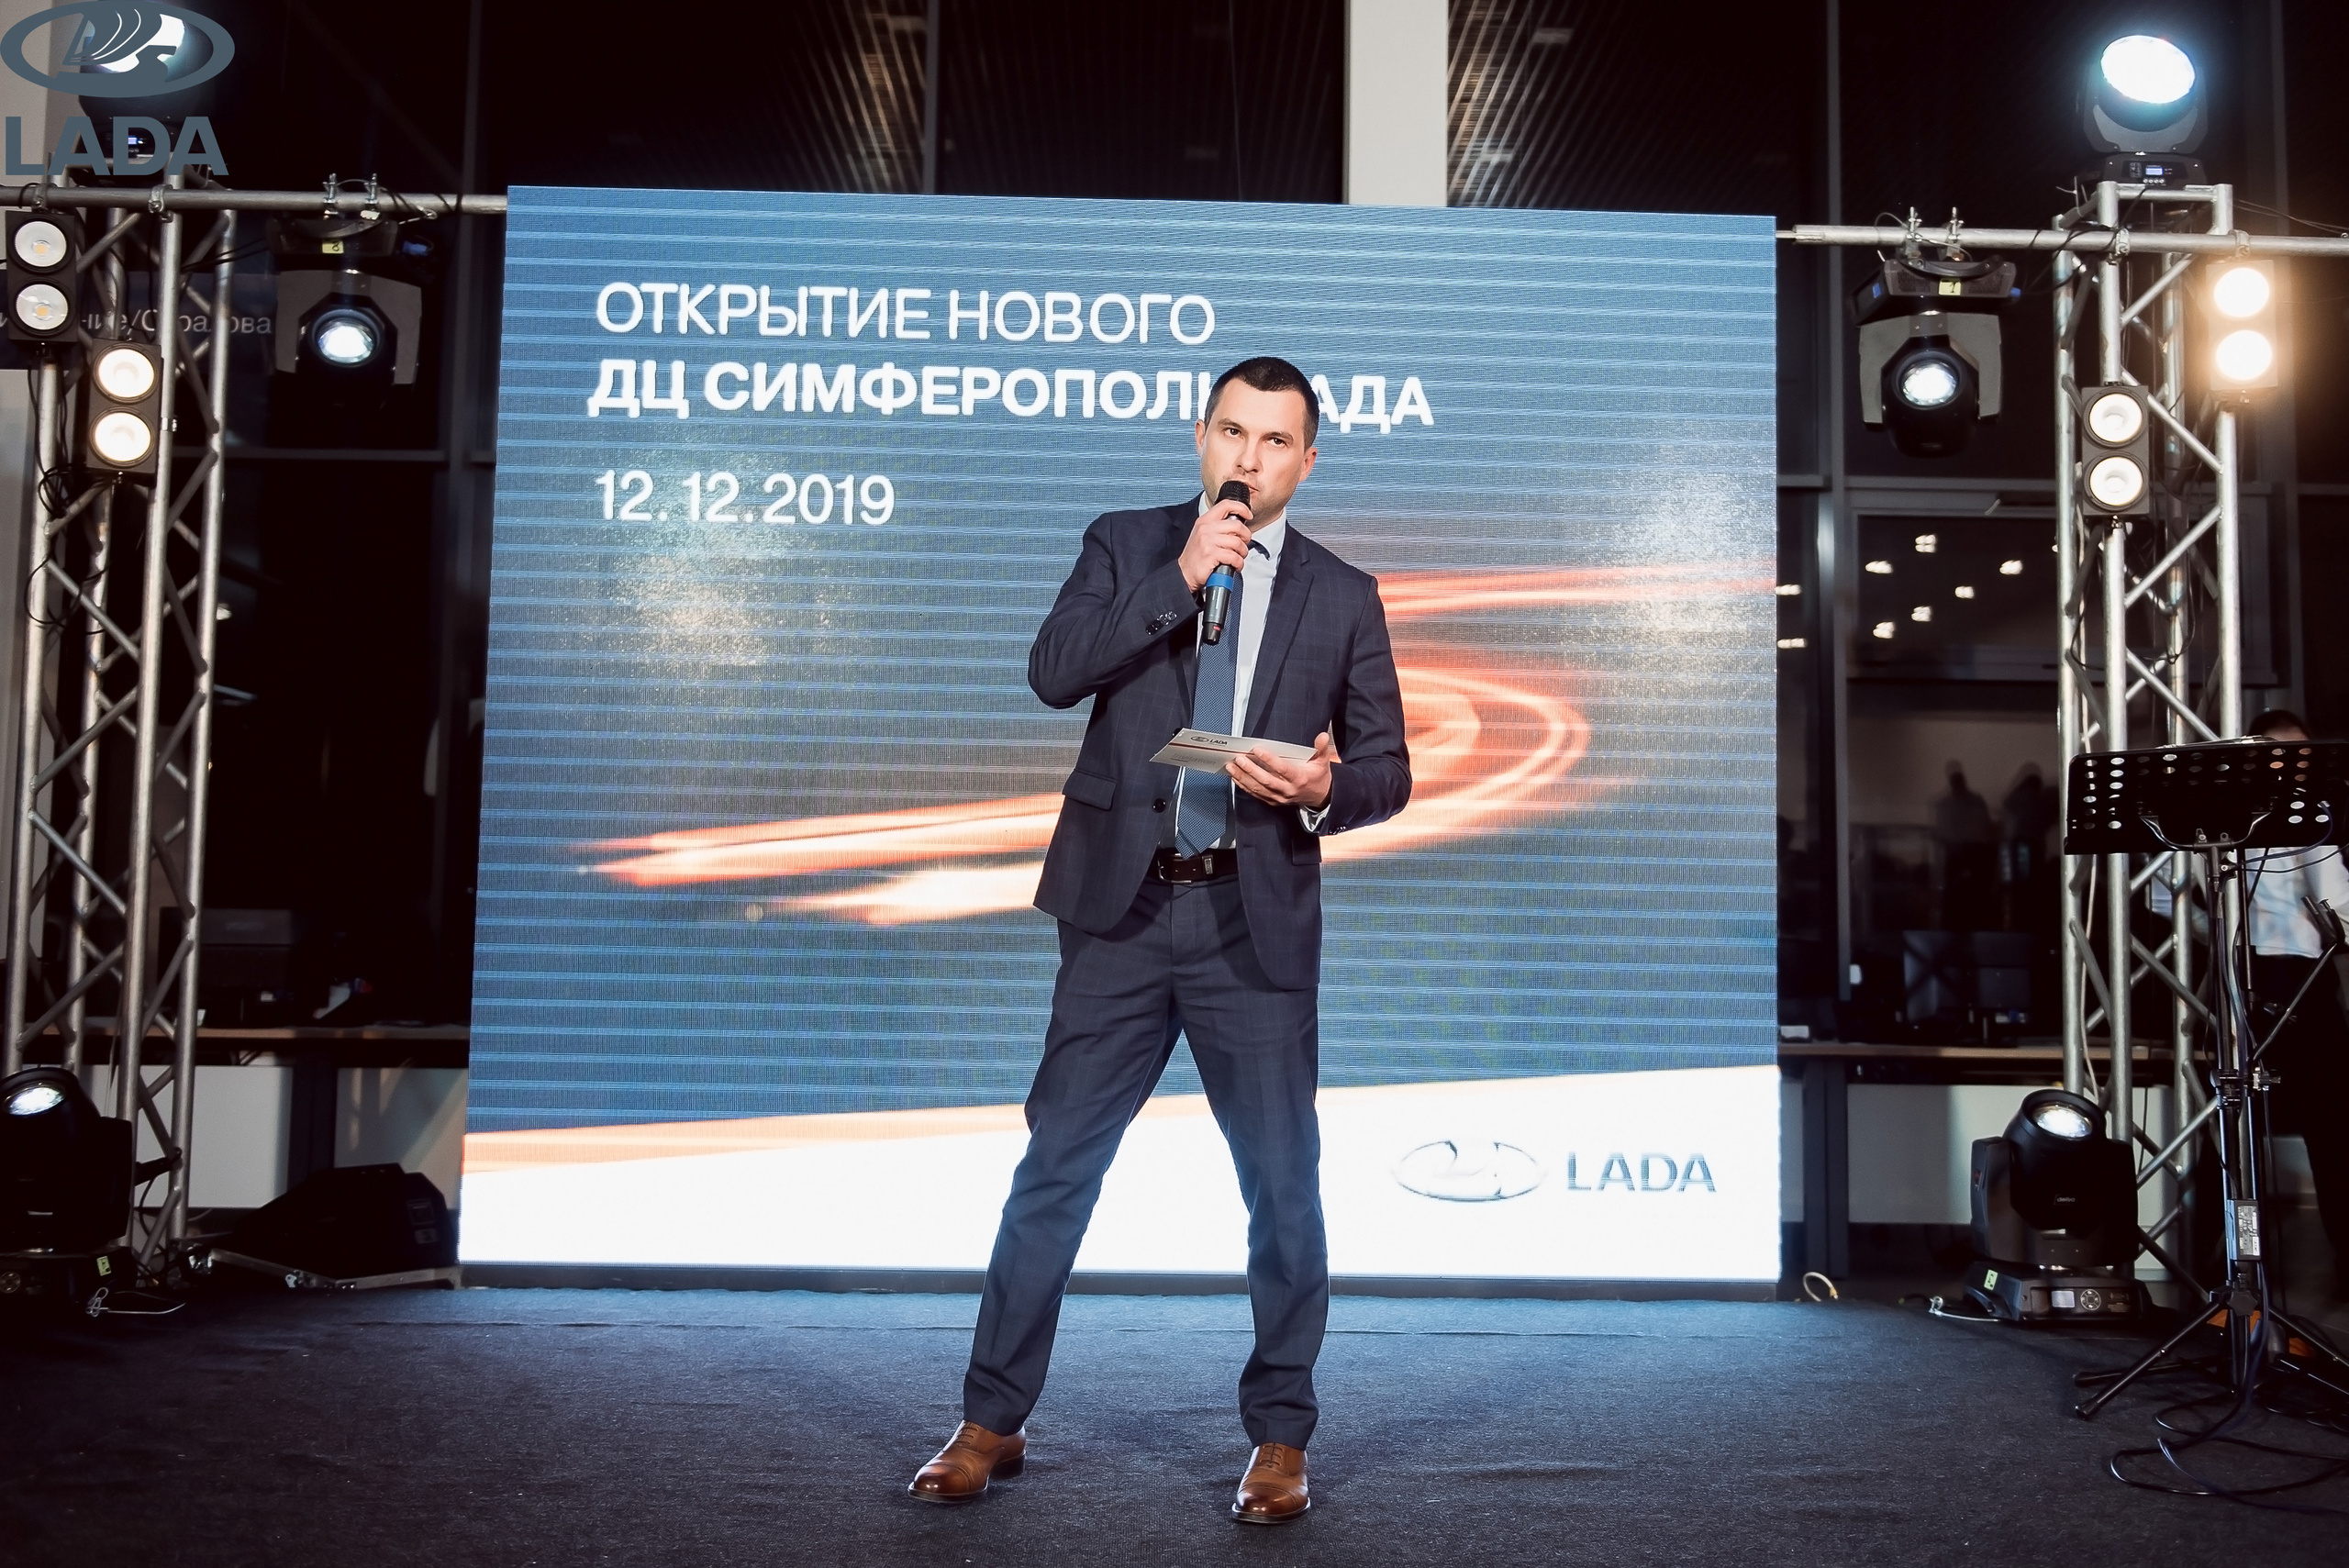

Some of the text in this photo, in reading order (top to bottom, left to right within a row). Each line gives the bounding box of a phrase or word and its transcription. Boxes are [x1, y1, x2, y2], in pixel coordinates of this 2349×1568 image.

[596, 281, 1216, 345] ОТКРЫТИЕ НОВОГО
[587, 358, 690, 420] ДЦ
[1309, 373, 1435, 435] АДА
[1567, 1151, 1718, 1193] LADA
